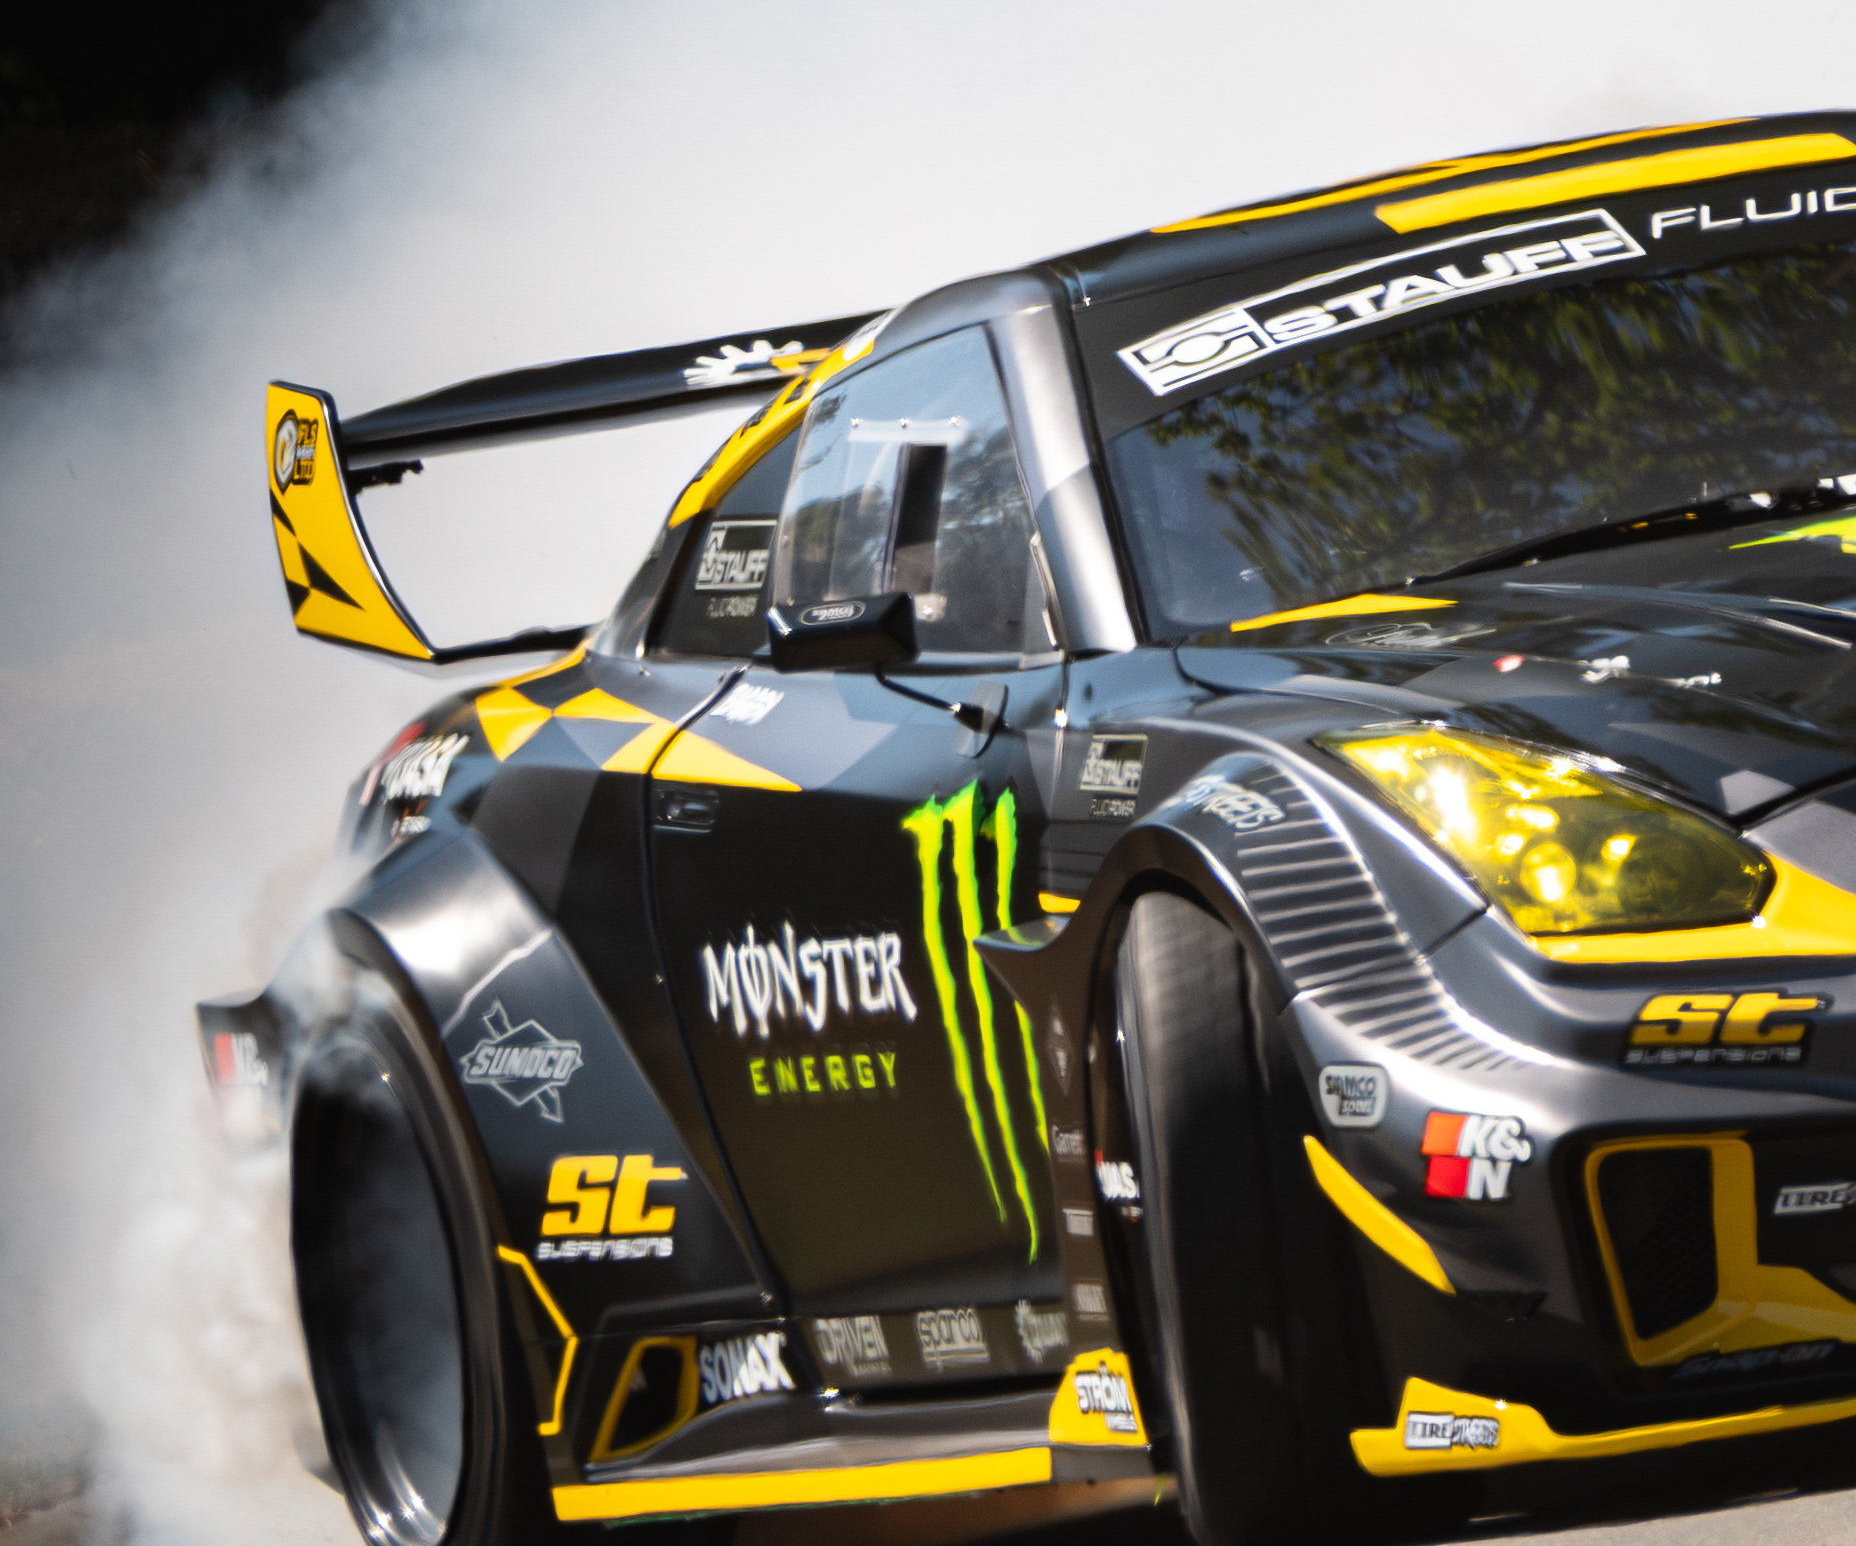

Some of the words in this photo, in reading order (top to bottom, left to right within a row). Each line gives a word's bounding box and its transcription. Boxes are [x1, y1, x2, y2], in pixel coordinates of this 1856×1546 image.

[1264, 230, 1627, 342] STAUFF
[712, 549, 769, 585] STAUFF
[703, 919, 919, 1040] MONSTER
[470, 1045, 579, 1080] SUNOCO
[748, 1051, 898, 1097] ENERGY
[815, 1315, 890, 1365] DRIVEN
[700, 1331, 797, 1405] SONAX
